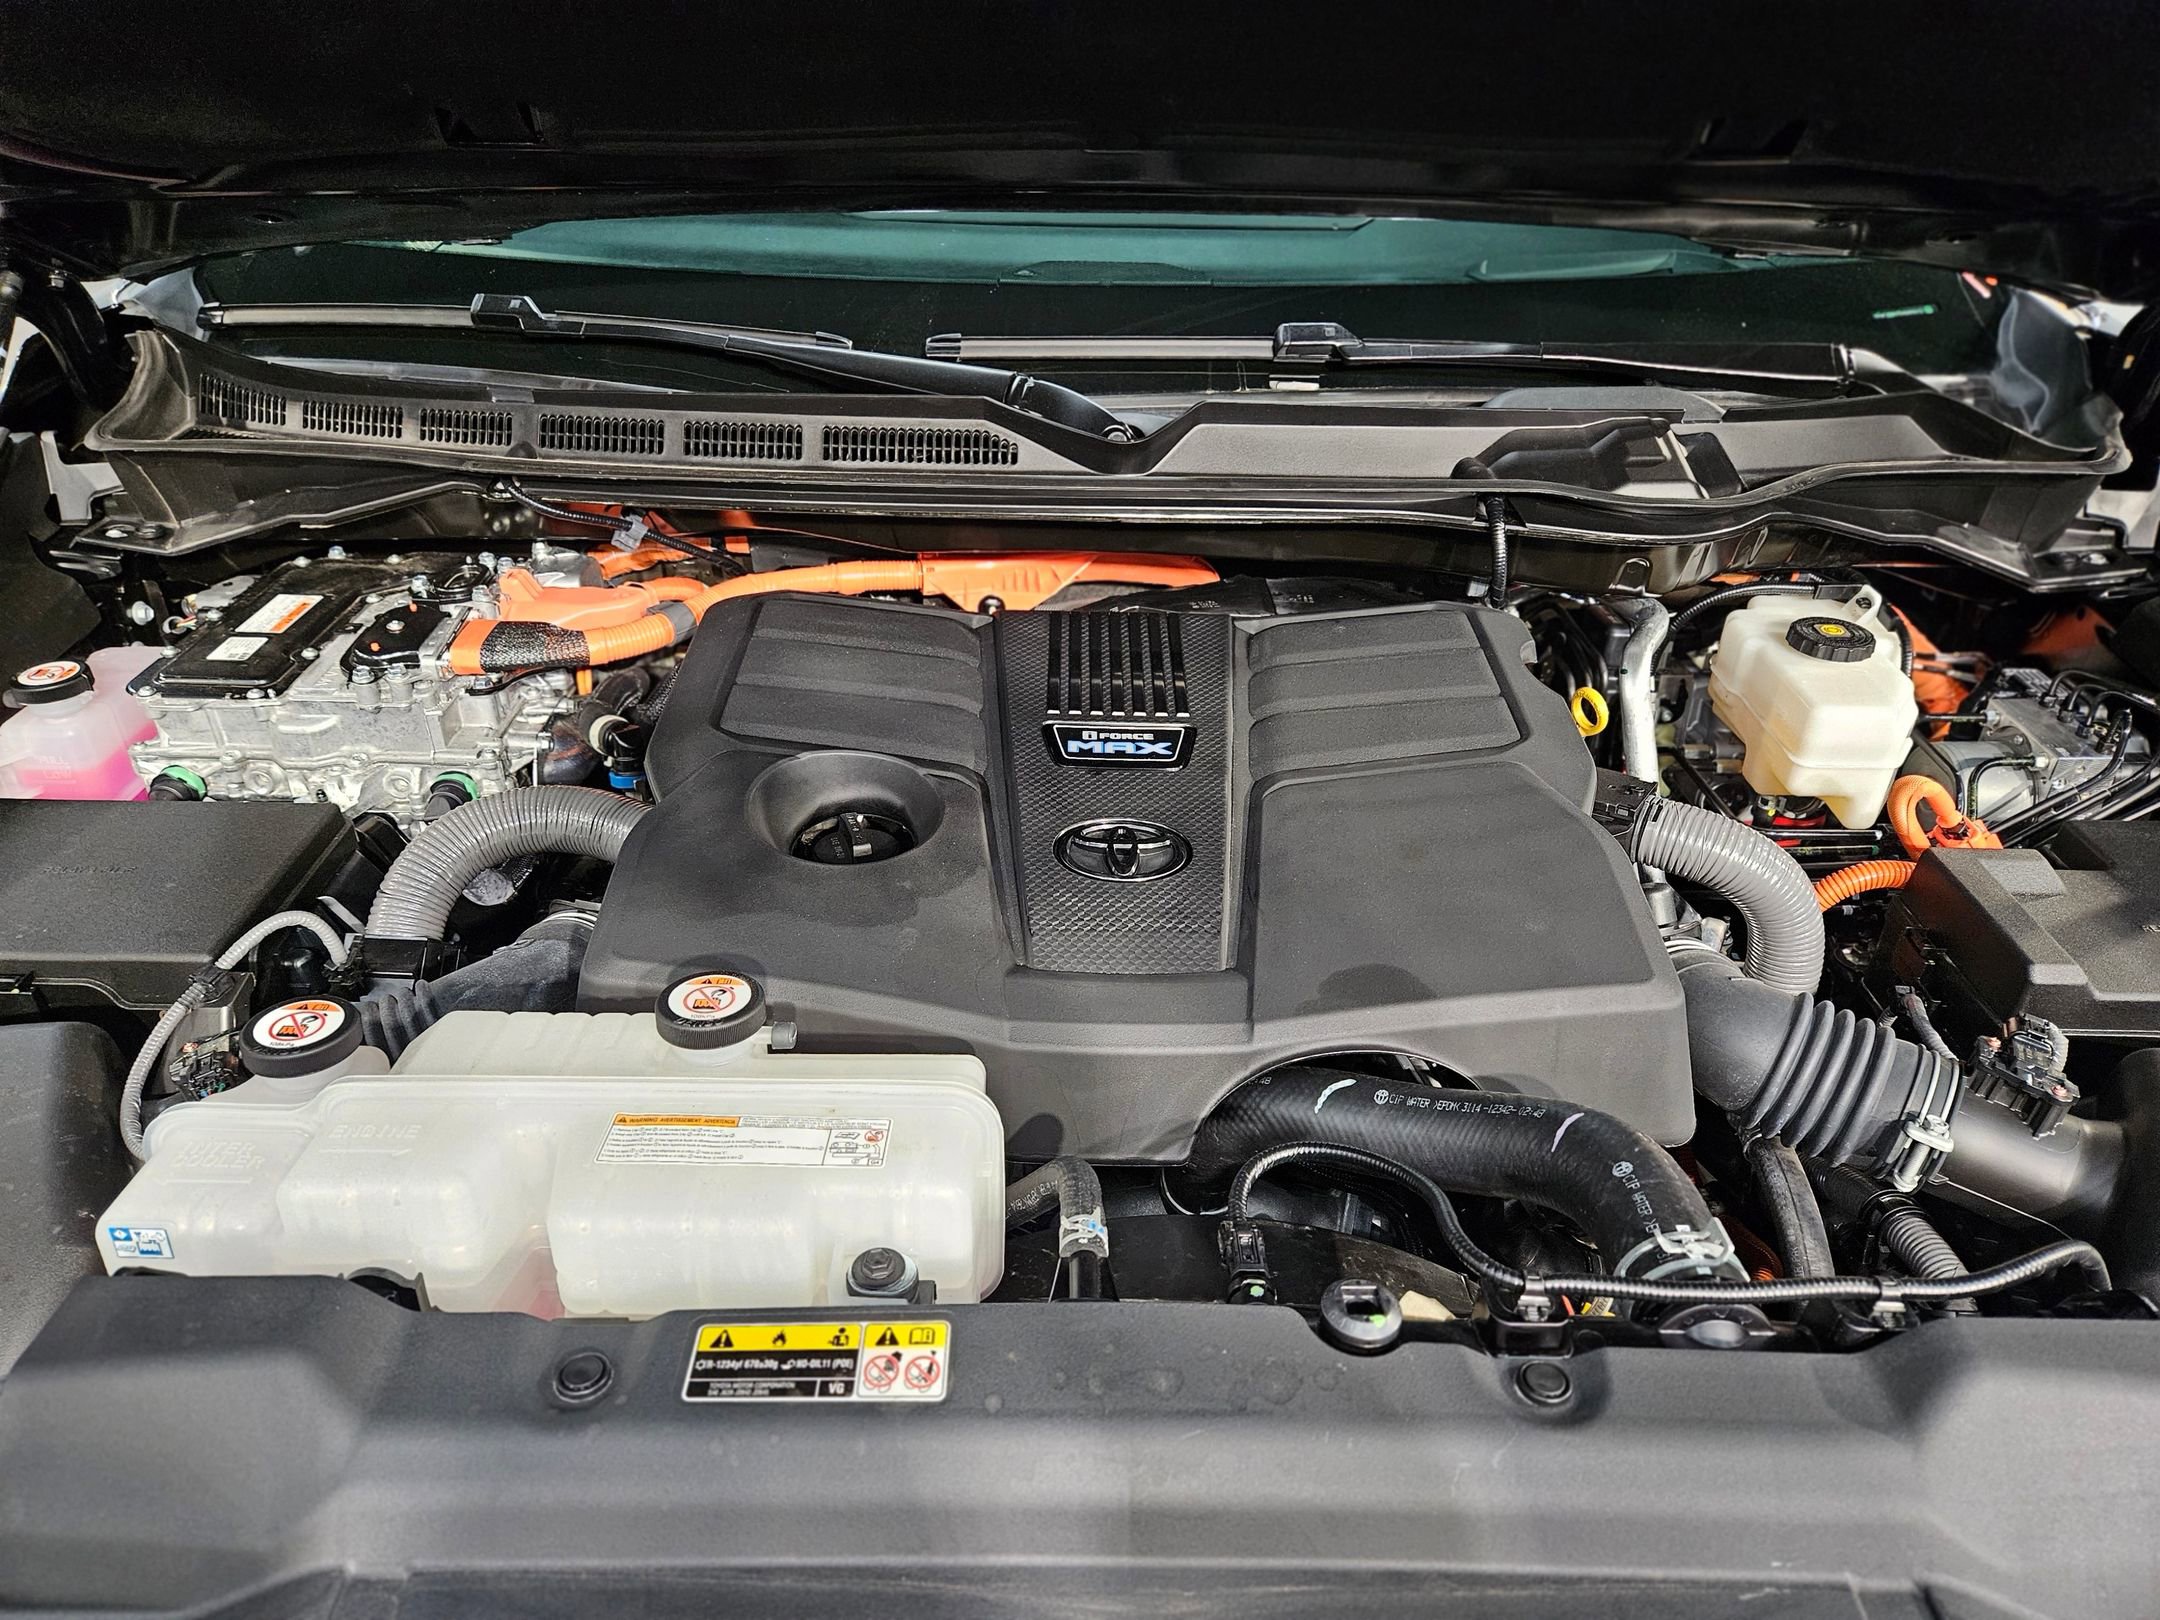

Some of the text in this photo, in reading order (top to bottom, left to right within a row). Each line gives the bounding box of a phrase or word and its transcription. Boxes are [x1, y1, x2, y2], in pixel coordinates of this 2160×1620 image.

[1067, 740, 1174, 755] MAX
[1406, 1096, 1431, 1109] WATER
[328, 1123, 422, 1139] ENGINE
[181, 1140, 257, 1155] INTER
[171, 1154, 265, 1170] COOLER
[1622, 1174, 1641, 1190] CIP
[1632, 1191, 1653, 1218] WATER
[828, 1382, 846, 1395] VG
